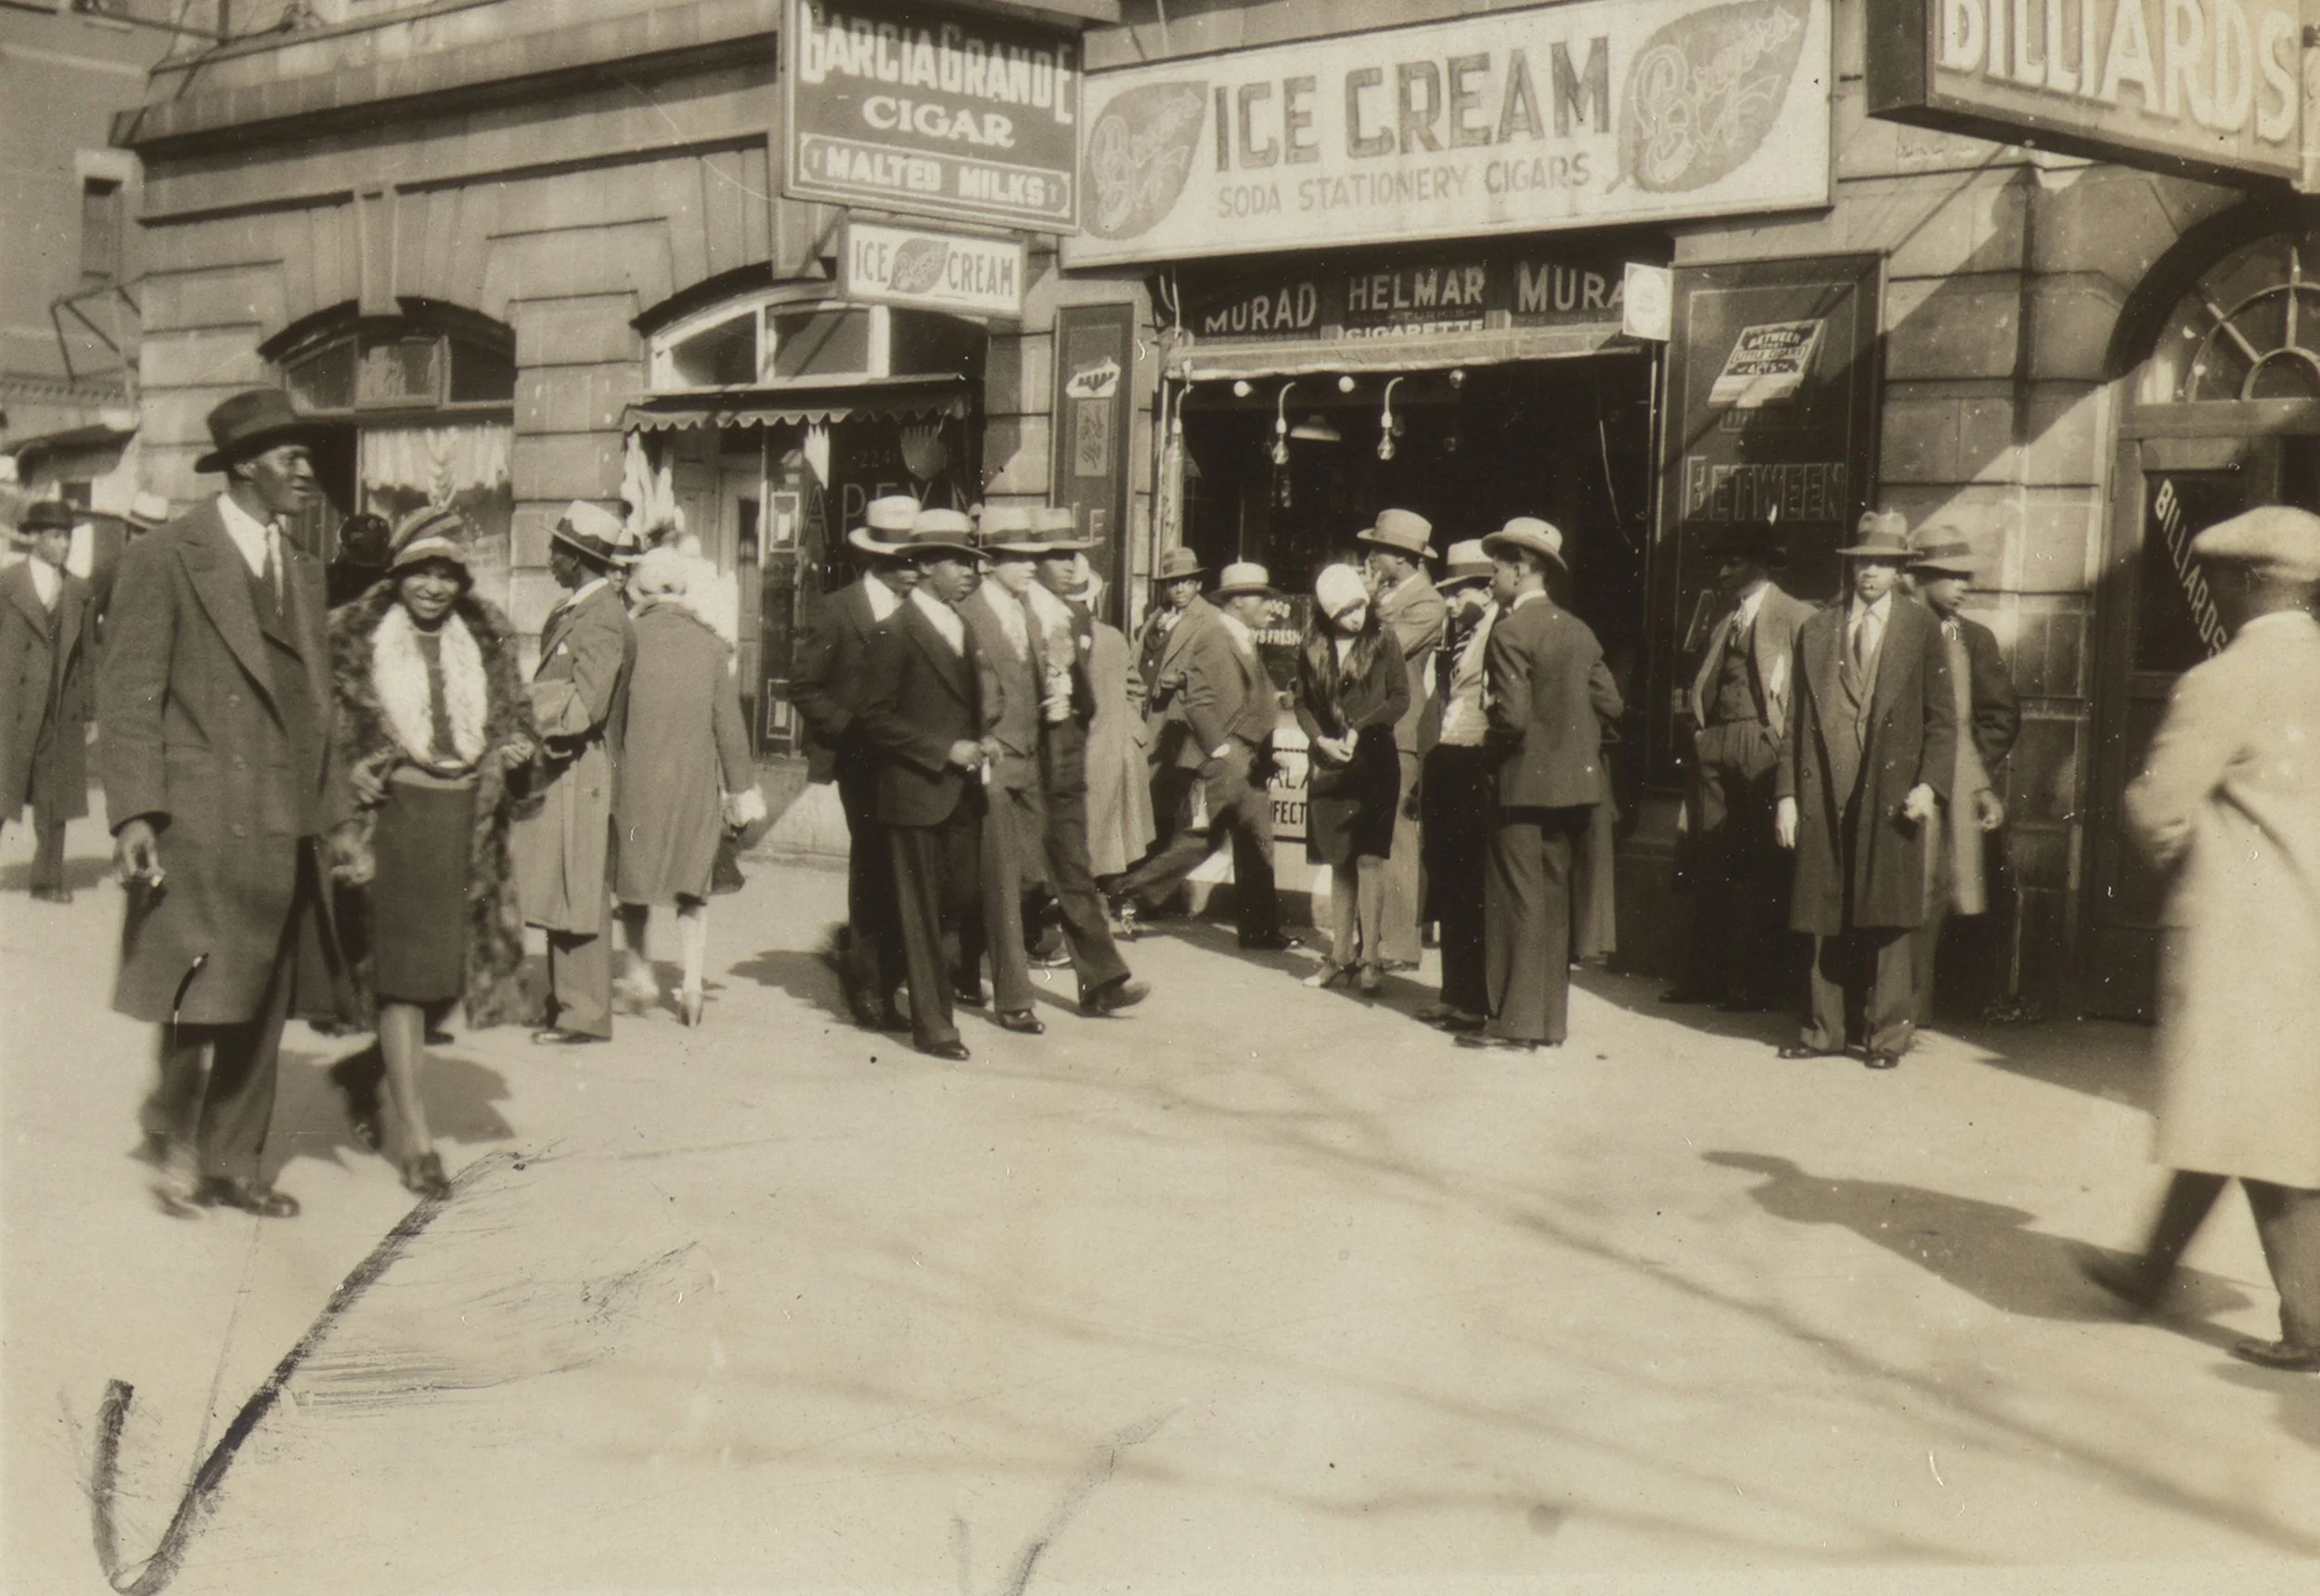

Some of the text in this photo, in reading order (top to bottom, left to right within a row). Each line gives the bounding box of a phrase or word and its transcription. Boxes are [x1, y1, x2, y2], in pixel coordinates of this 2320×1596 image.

[862, 96, 1015, 148] CIGAR
[1215, 35, 1610, 173] ICE CREAM
[827, 147, 1045, 206] MALTED MILKS
[1217, 152, 1591, 219] SODA STATIONERY CIGARS
[855, 240, 887, 283] ICE
[947, 251, 1013, 296] CREAM
[1348, 266, 1485, 312] HELMAR
[1518, 262, 1625, 312] MURA
[1205, 283, 1317, 333] MURAD
[1686, 457, 1845, 521] BETWEEN
